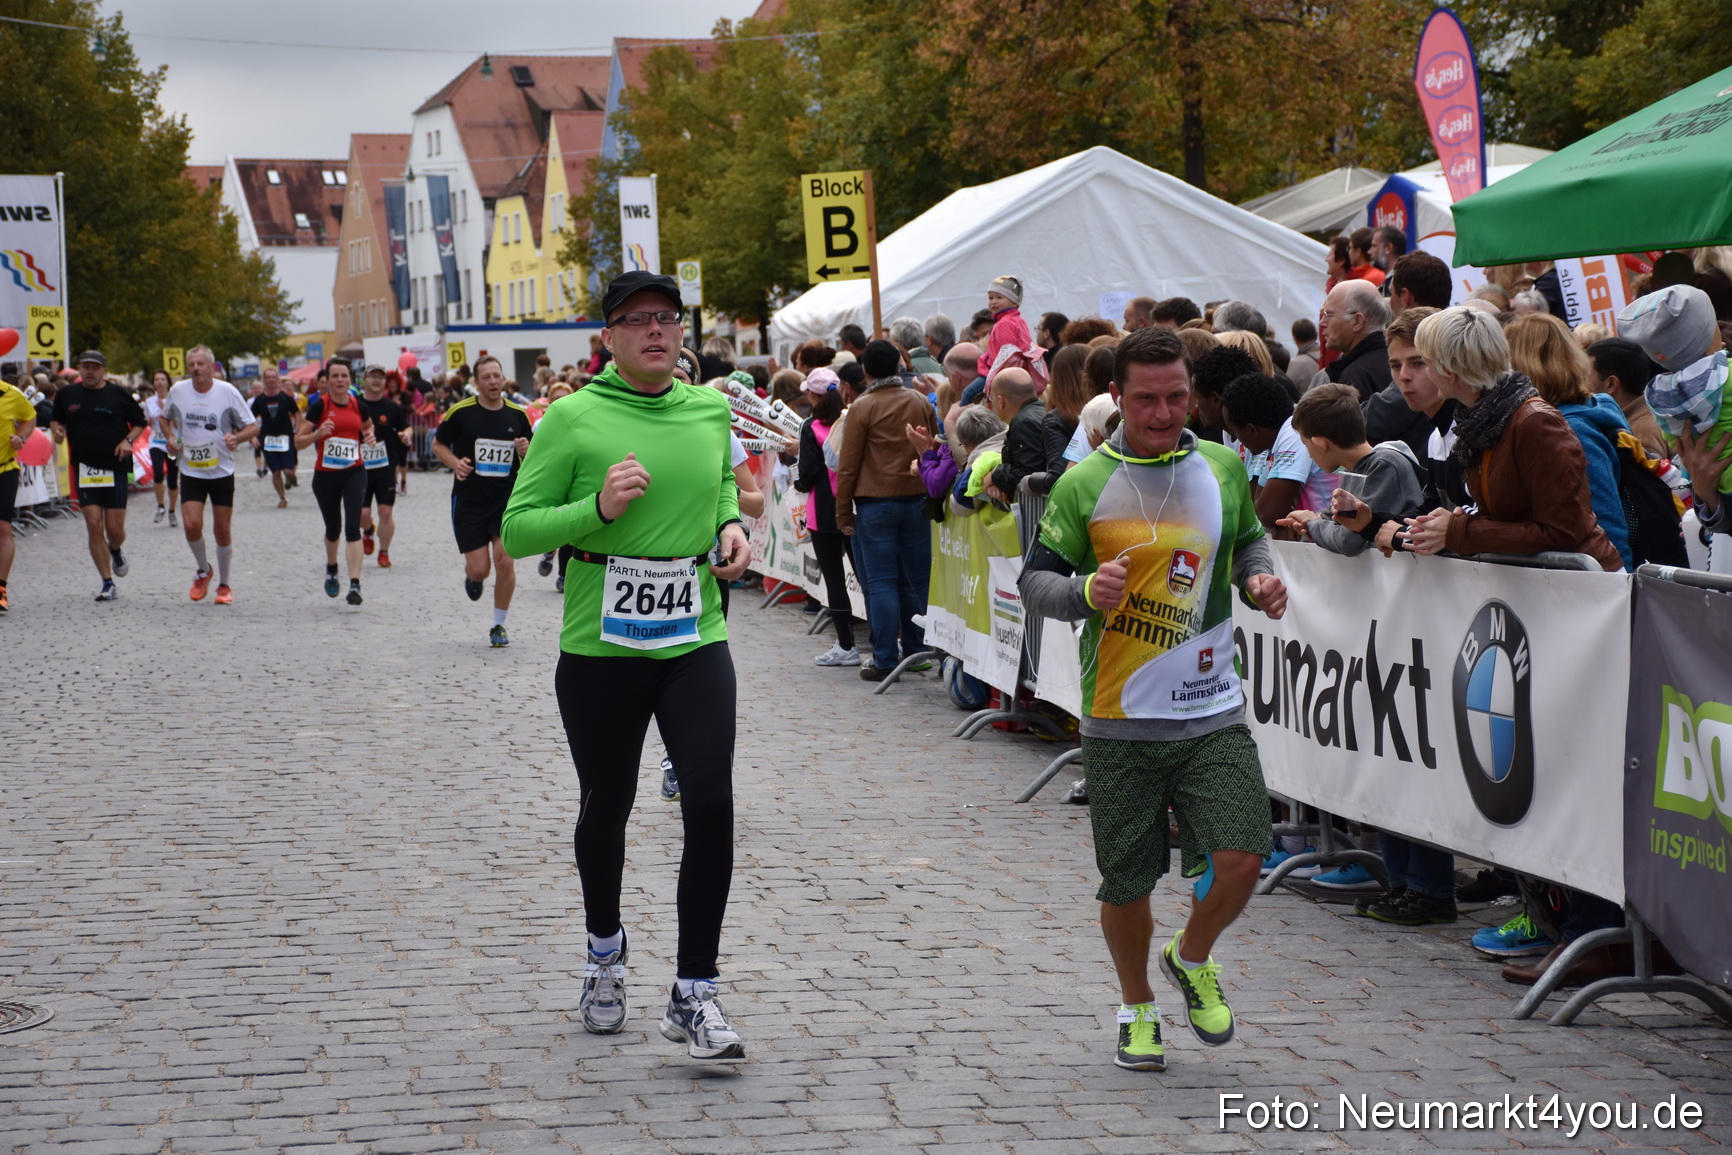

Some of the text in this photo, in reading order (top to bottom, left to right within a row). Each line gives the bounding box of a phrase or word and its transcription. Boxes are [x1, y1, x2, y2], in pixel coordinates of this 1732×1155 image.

[810, 176, 865, 198] Block
[822, 205, 859, 258] B
[31, 307, 60, 318] Block
[36, 321, 55, 348] C
[169, 356, 179, 370] D
[451, 349, 462, 364] D
[185, 413, 207, 422] Allianz
[748, 407, 763, 418] Lau
[743, 420, 765, 435] BMW
[190, 447, 211, 461] 232
[328, 443, 355, 458] 2041
[362, 447, 385, 460] 2776
[479, 447, 511, 463] 2412
[608, 564, 688, 579] PARTL Neumarkt
[1172, 583, 1188, 594] 1628
[613, 580, 693, 616] 2644
[624, 623, 678, 638] Thorsten
[1461, 606, 1529, 683] BMW
[1650, 818, 1727, 874] inspired
